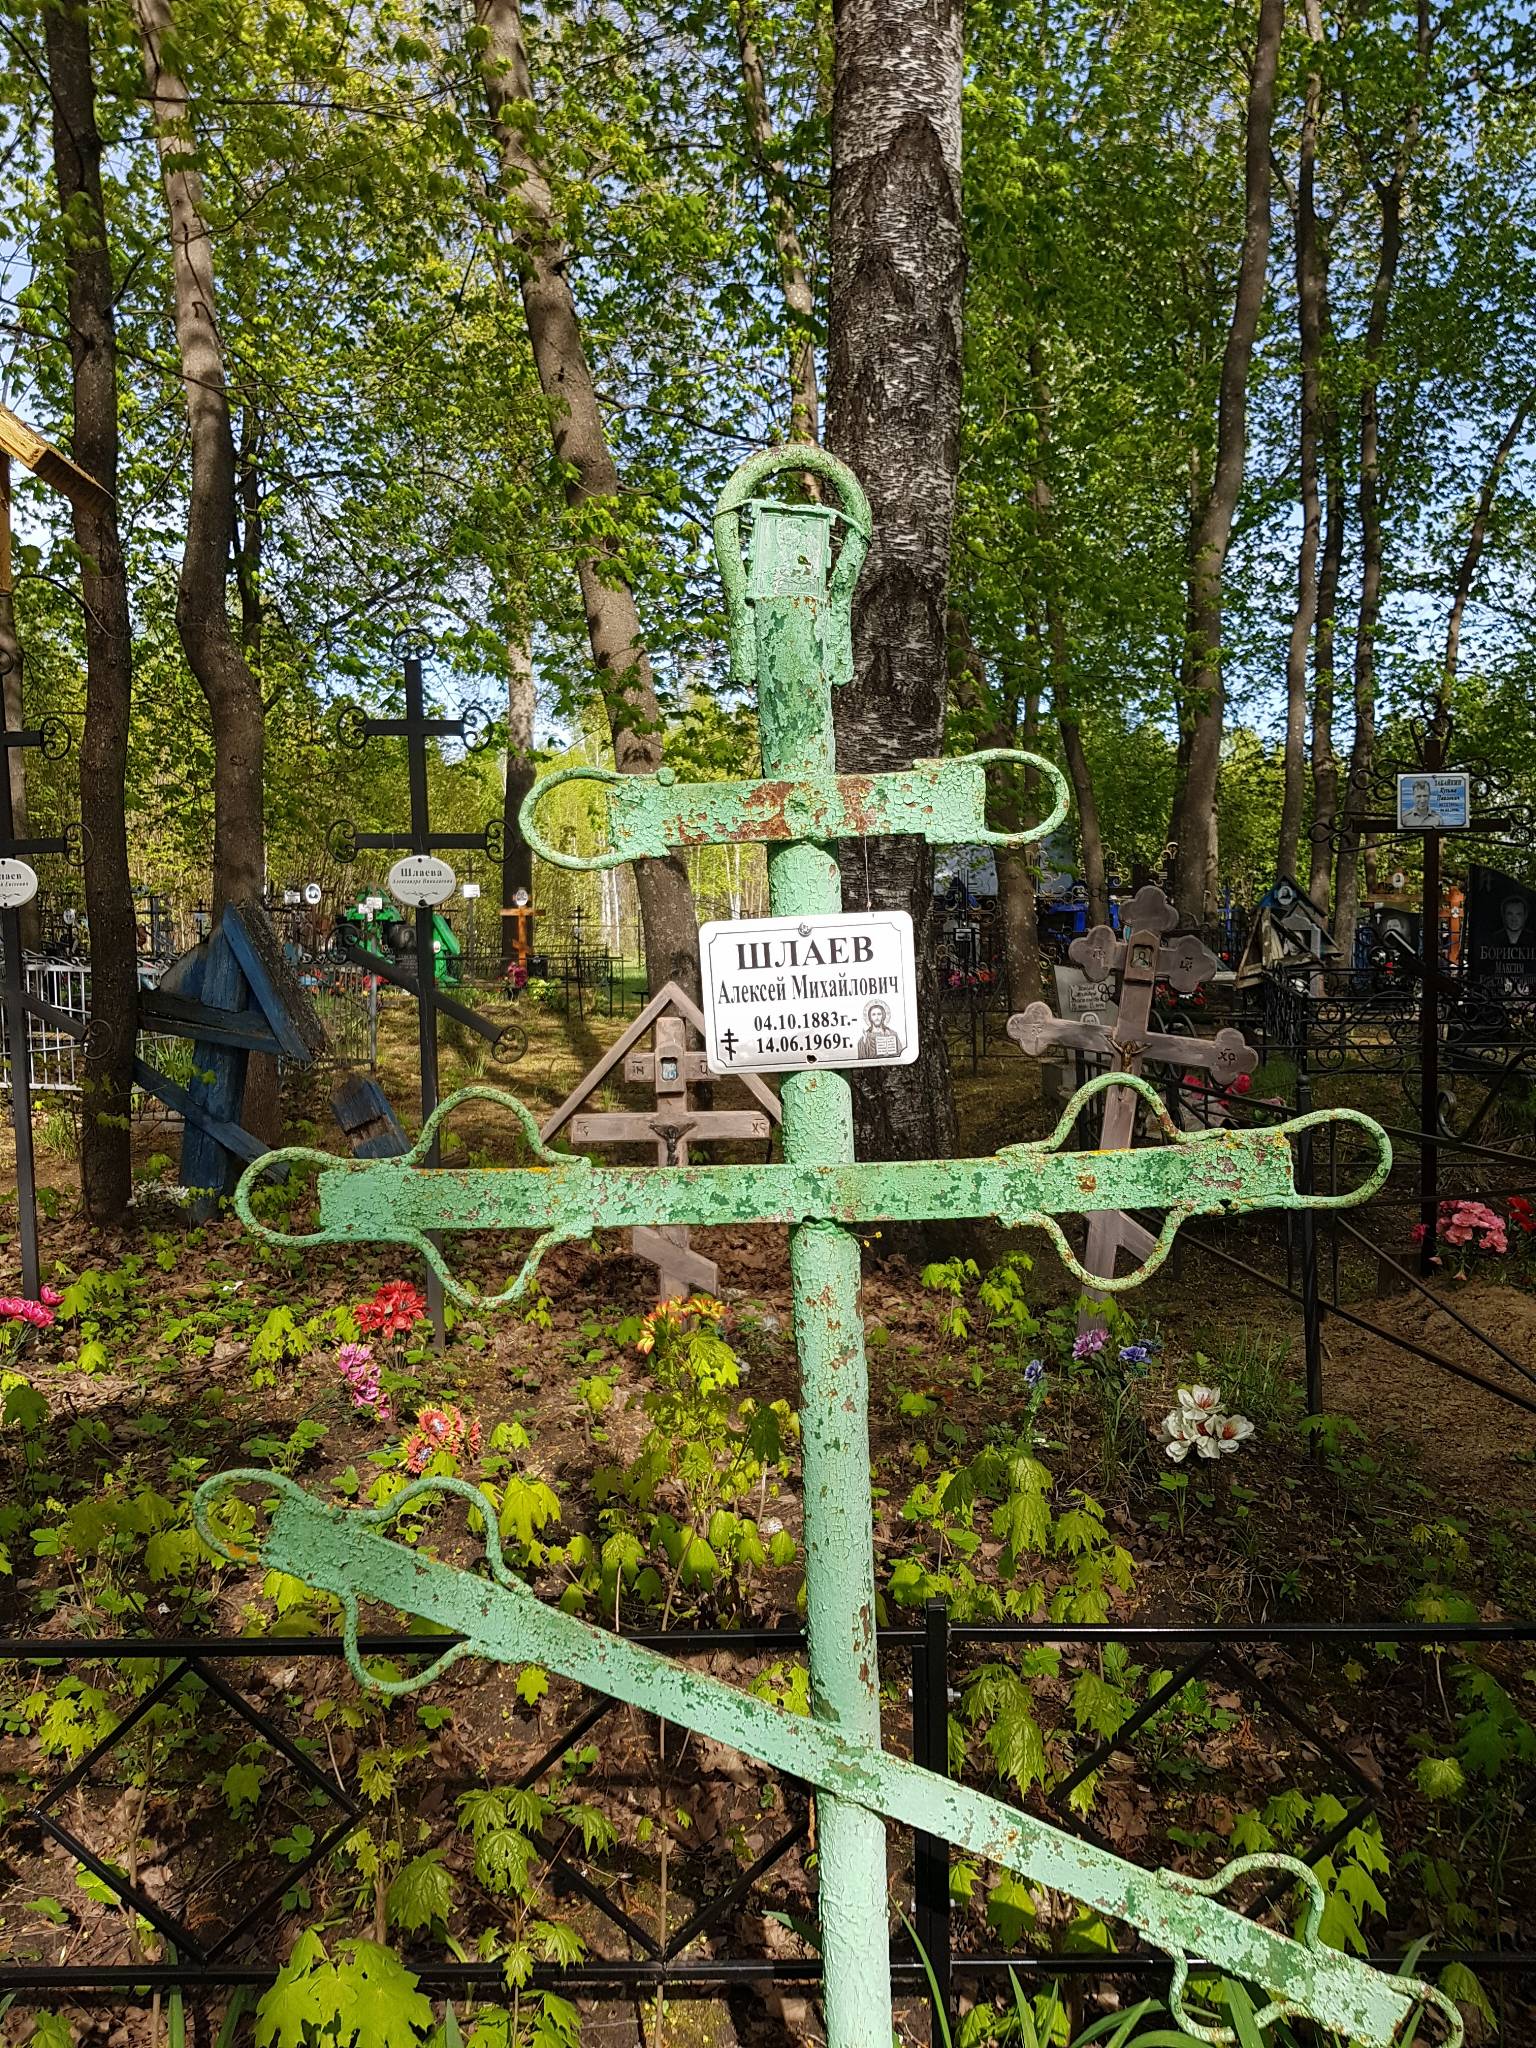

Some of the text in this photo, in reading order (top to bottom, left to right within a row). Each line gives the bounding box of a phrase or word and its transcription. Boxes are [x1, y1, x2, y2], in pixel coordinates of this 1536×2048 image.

[401, 868, 442, 877] Шлаева
[736, 935, 874, 970] ШЛАЕВ
[1480, 945, 1536, 960] БОРИСКИ
[718, 972, 899, 1004] Алексей Михайлович
[754, 1011, 858, 1032] 04.10.1883г.-
[757, 1033, 853, 1054] 14.06.1969г.
